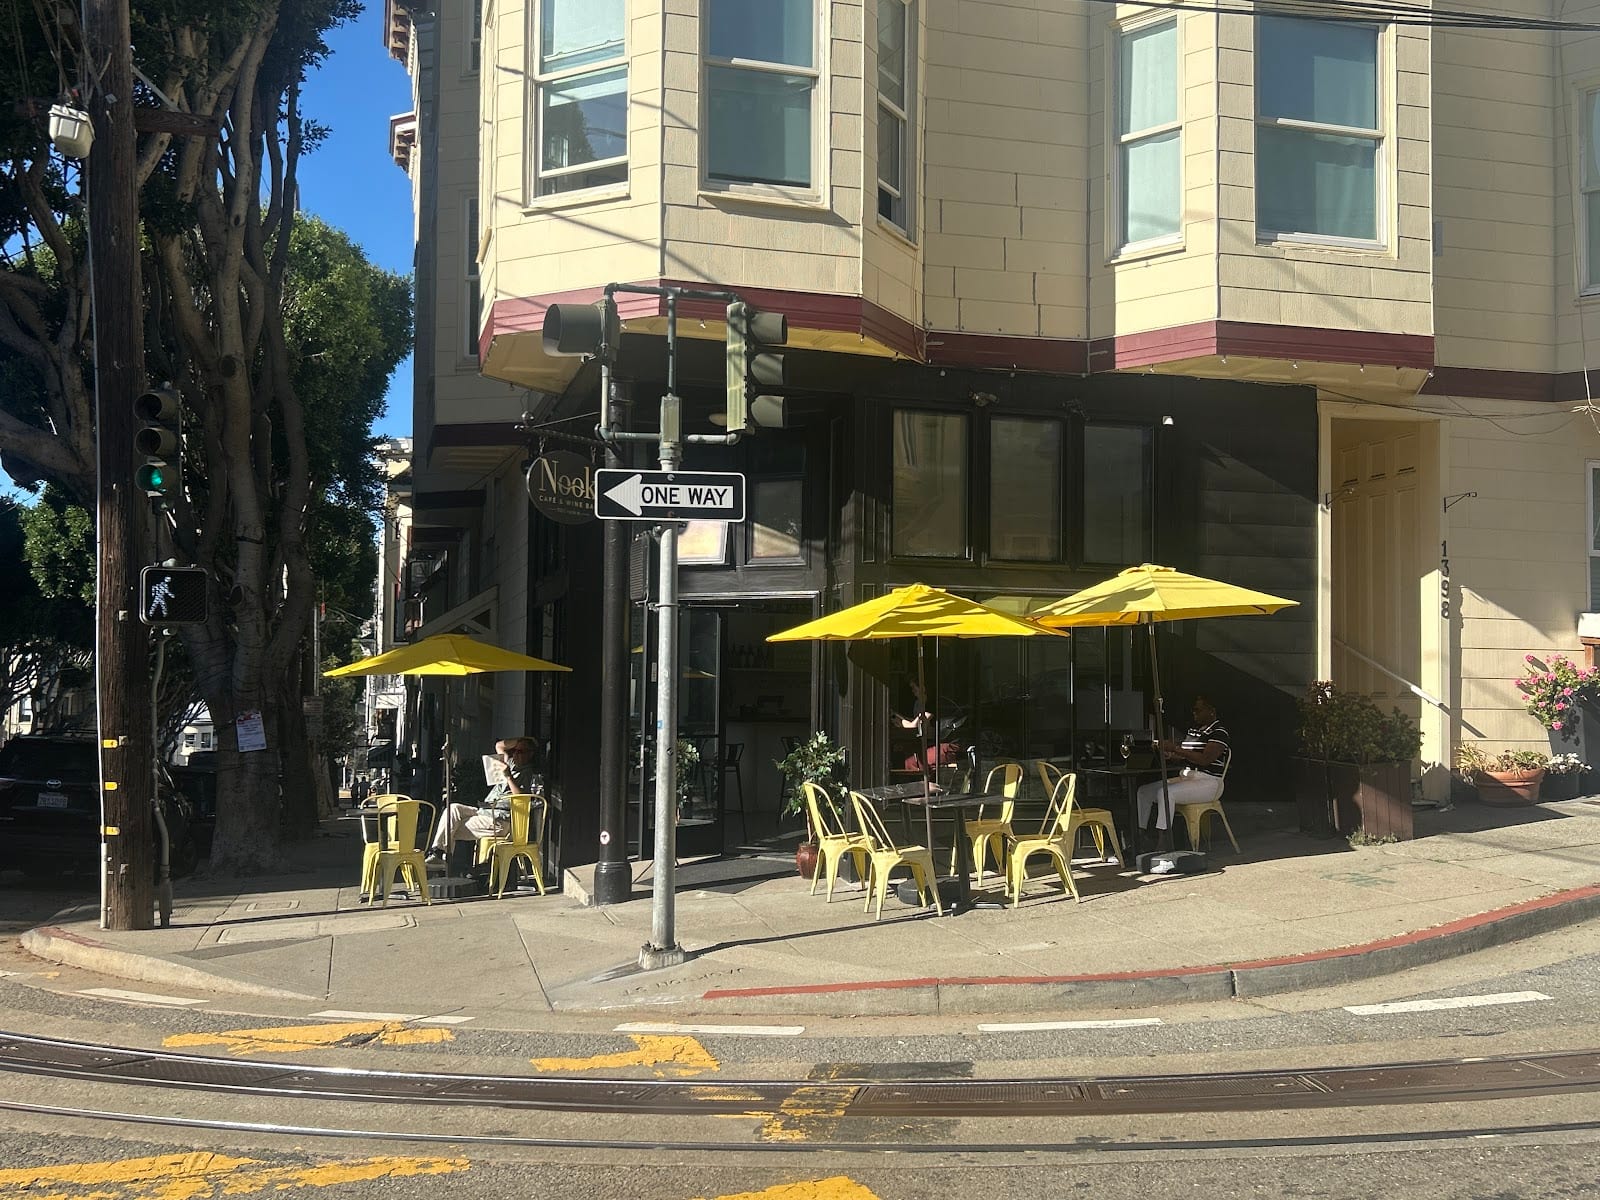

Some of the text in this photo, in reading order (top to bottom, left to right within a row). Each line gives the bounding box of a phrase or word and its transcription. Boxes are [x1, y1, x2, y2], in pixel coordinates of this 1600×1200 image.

[538, 458, 595, 500] Nook
[641, 487, 728, 505] ONE WAY
[1441, 540, 1449, 619] 1398
